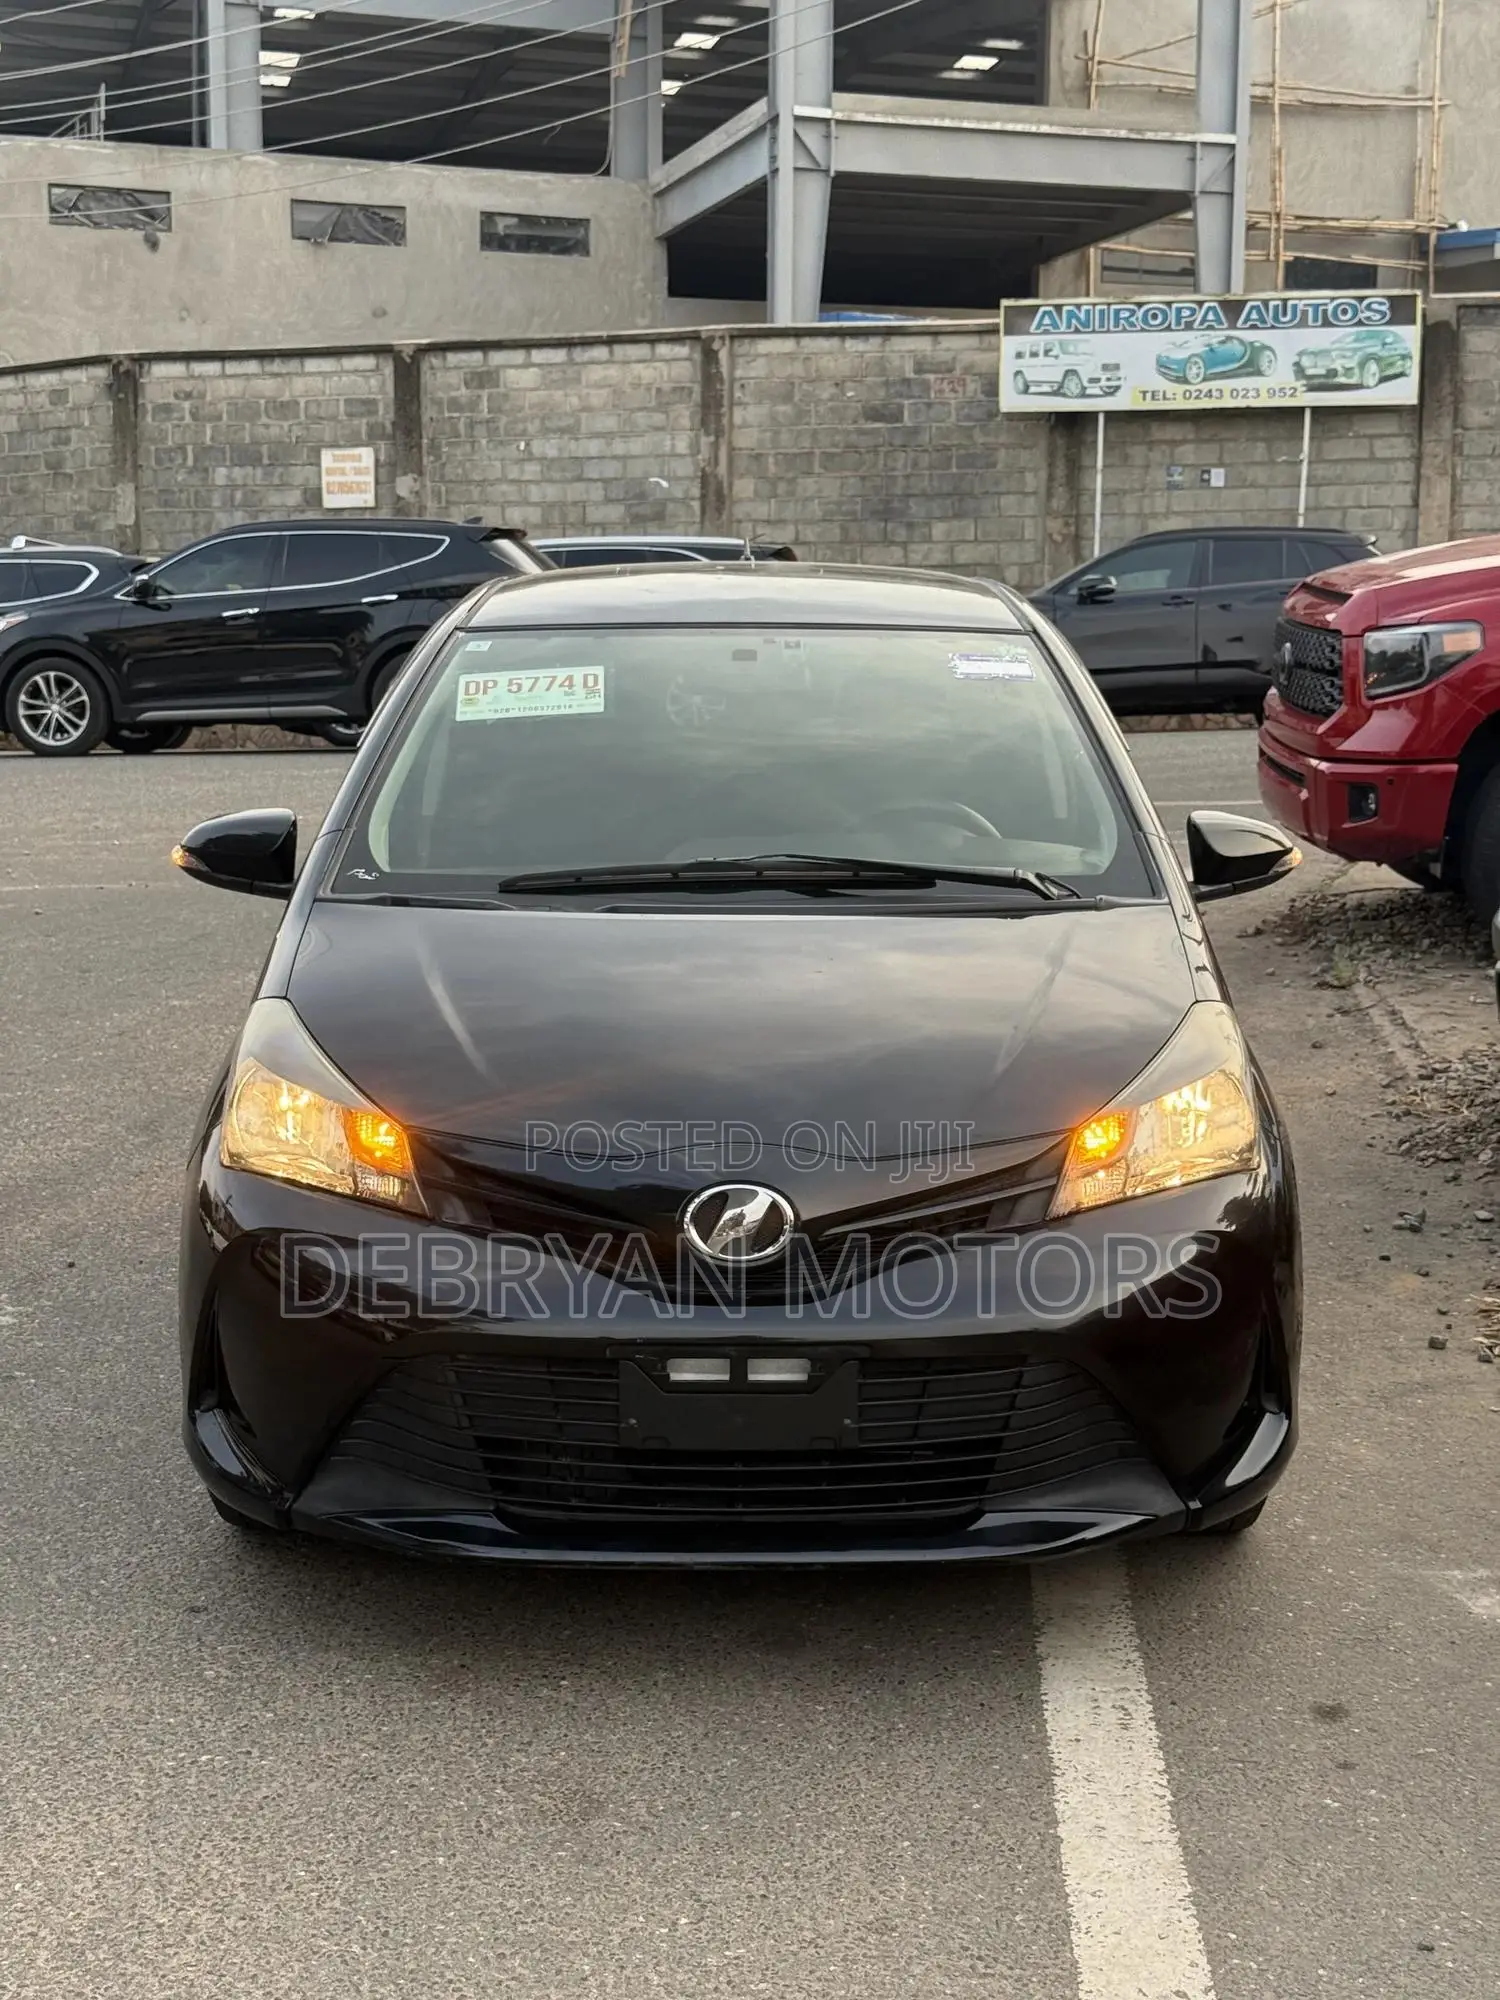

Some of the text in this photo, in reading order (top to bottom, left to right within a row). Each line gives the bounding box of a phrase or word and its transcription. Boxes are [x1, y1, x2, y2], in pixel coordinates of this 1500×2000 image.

[1030, 299, 1391, 333] ANIROPA AUTOS
[1138, 386, 1298, 401] TEL: 0243 023 952
[464, 679, 498, 696] DP
[507, 674, 576, 694] 5774
